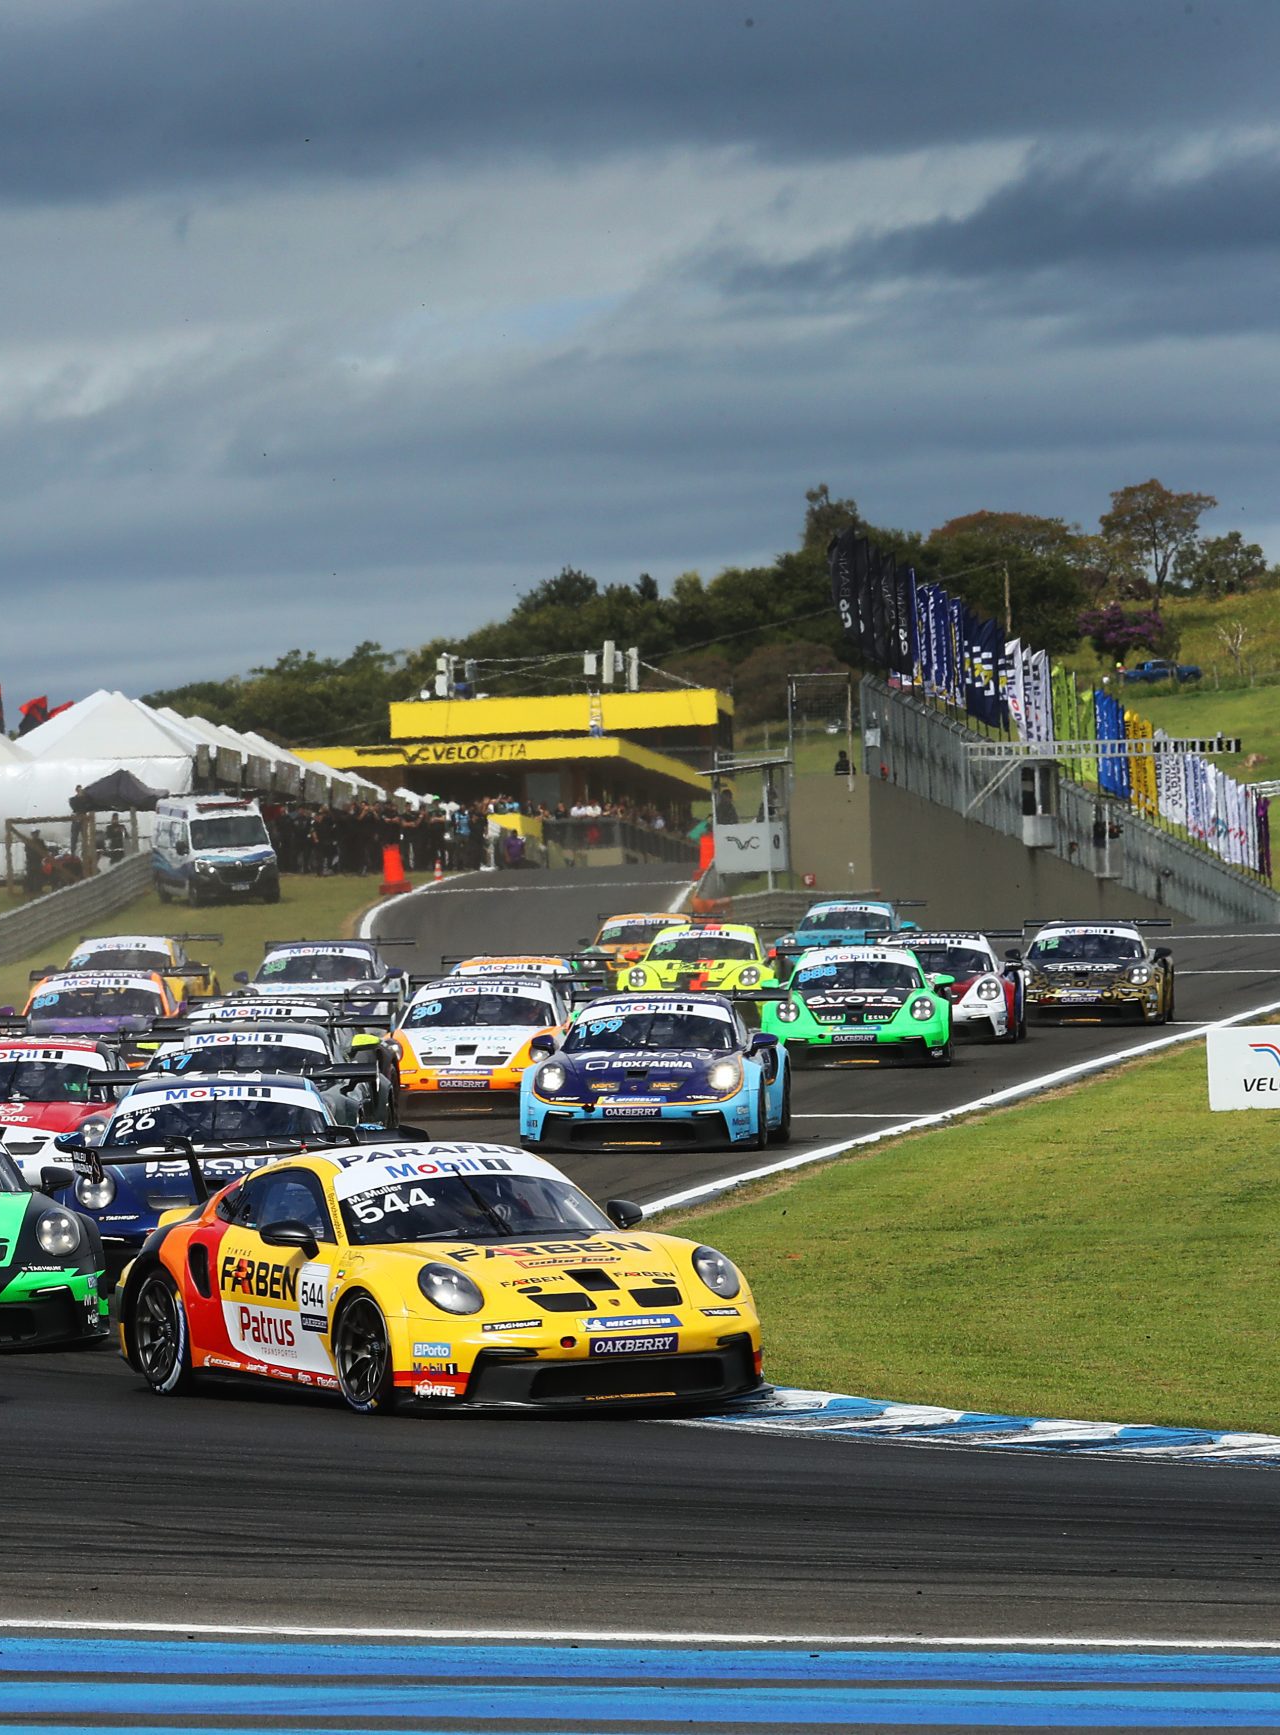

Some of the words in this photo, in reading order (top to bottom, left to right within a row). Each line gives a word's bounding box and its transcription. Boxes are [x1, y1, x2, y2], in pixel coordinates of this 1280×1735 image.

[434, 744, 527, 760] VELOCITTA
[1037, 937, 1059, 951] 12
[825, 953, 869, 962] Mobil
[479, 963, 524, 972] Mobil
[63, 979, 111, 987] Mobil
[448, 986, 500, 995] Mobil
[220, 1007, 274, 1017] Mobil
[412, 1001, 442, 1020] 30
[614, 1003, 672, 1013] Mobil
[574, 1019, 623, 1039] 199
[195, 1033, 259, 1045] Mobil
[158, 1054, 193, 1069] 17
[611, 1060, 693, 1069] BOXFARMA
[439, 1080, 488, 1088] OAKBERRY
[1243, 1077, 1280, 1092] VEL
[165, 1086, 242, 1101] Mobil
[135, 1106, 161, 1118] Hahn
[605, 1108, 658, 1116] OAKBERRY
[115, 1113, 156, 1138] 26
[337, 1145, 524, 1169] PARAFLU
[385, 1158, 480, 1179] Mobil
[347, 1193, 366, 1205] M.
[368, 1184, 402, 1200] Muller
[351, 1187, 436, 1225] 544
[226, 1247, 252, 1257] TINTAS
[446, 1241, 653, 1262] FARBEN
[220, 1256, 301, 1302] FARBEN
[500, 1275, 565, 1288] FARBEN
[613, 1271, 676, 1279] FARBEN
[301, 1281, 324, 1309] 544
[239, 1306, 295, 1347] Patrus
[492, 1320, 541, 1330] TAGHeuer
[605, 1317, 672, 1327] MICHELIN
[422, 1343, 449, 1356] Porto
[594, 1336, 675, 1354] OAKBERRY
[413, 1362, 443, 1375] Mobil
[447, 1363, 457, 1375] 1
